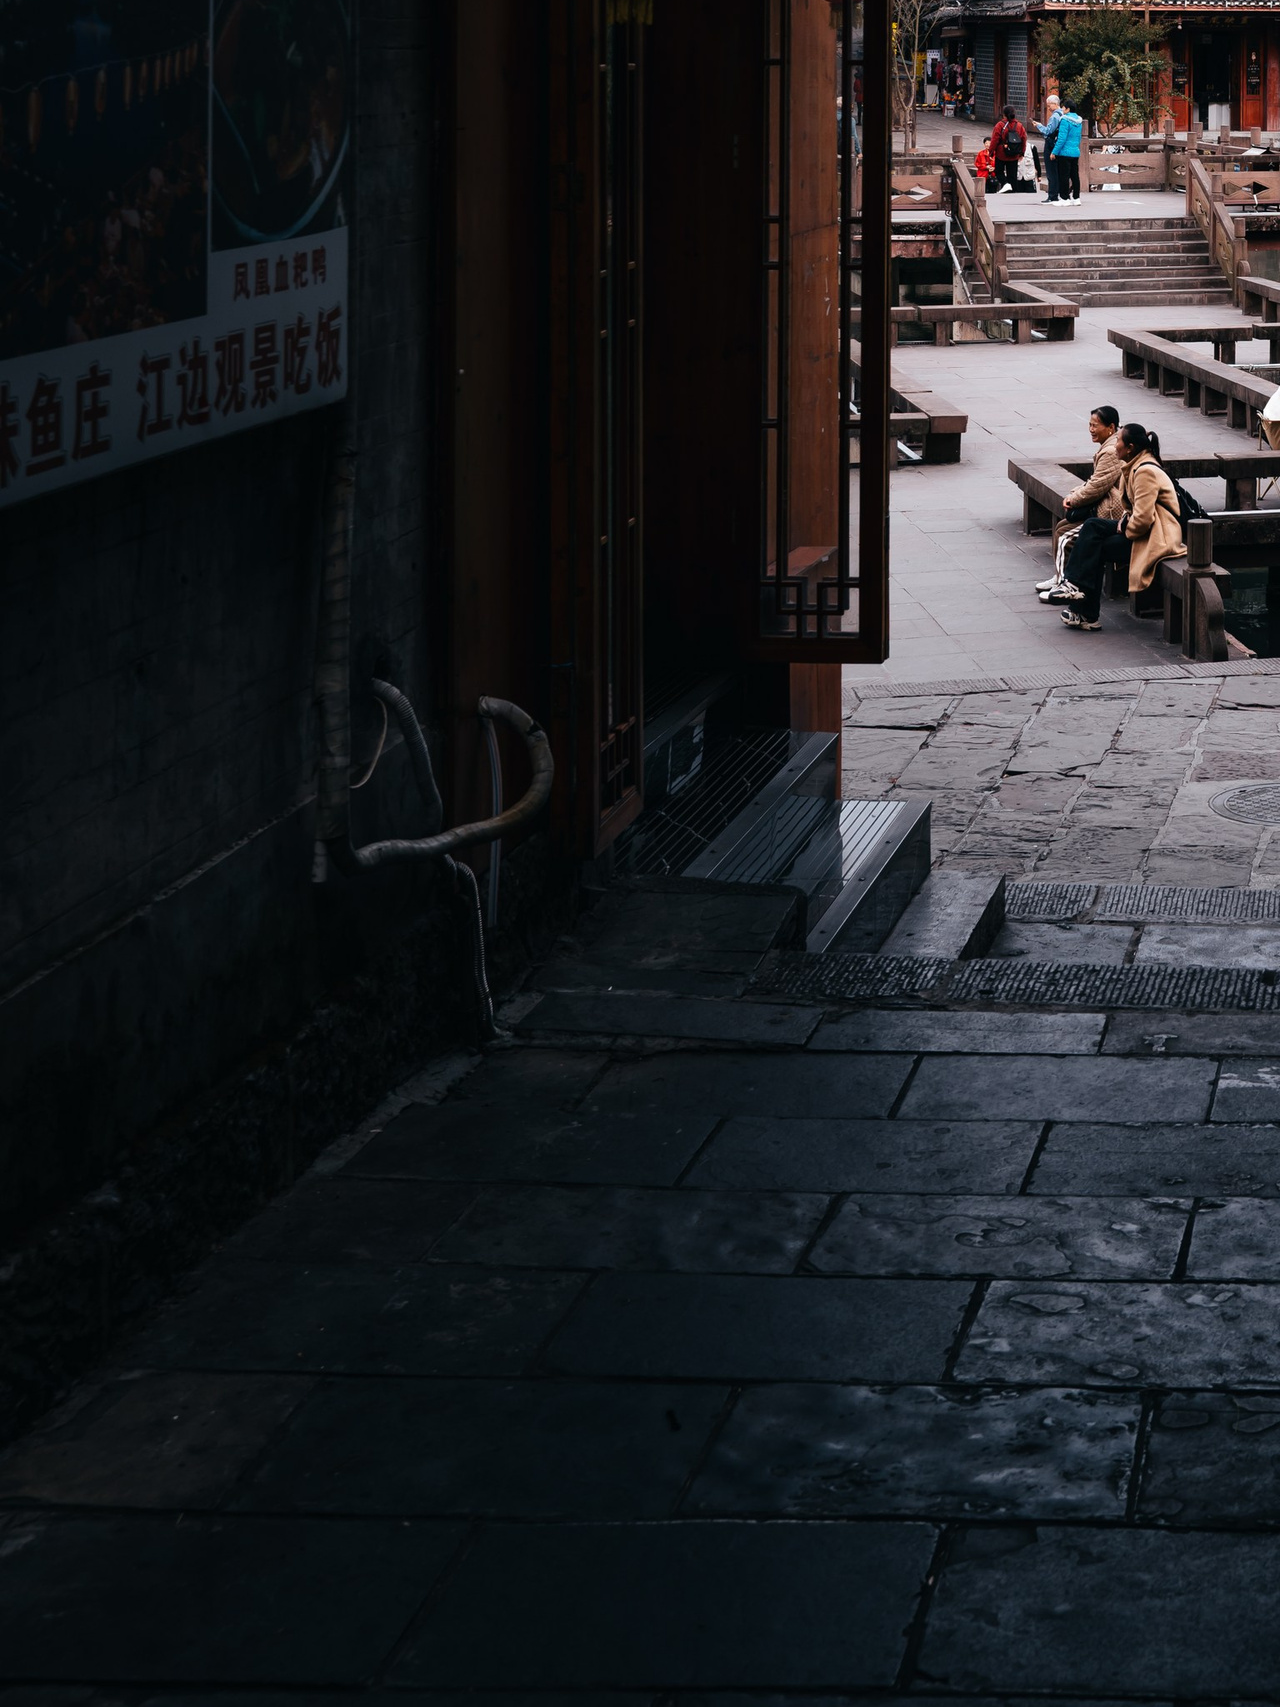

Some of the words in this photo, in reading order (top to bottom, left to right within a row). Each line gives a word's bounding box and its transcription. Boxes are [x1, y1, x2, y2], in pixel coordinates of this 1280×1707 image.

[233, 245, 328, 302] 凤凰血粑鸭
[137, 304, 342, 443] 江边观景吃饭
